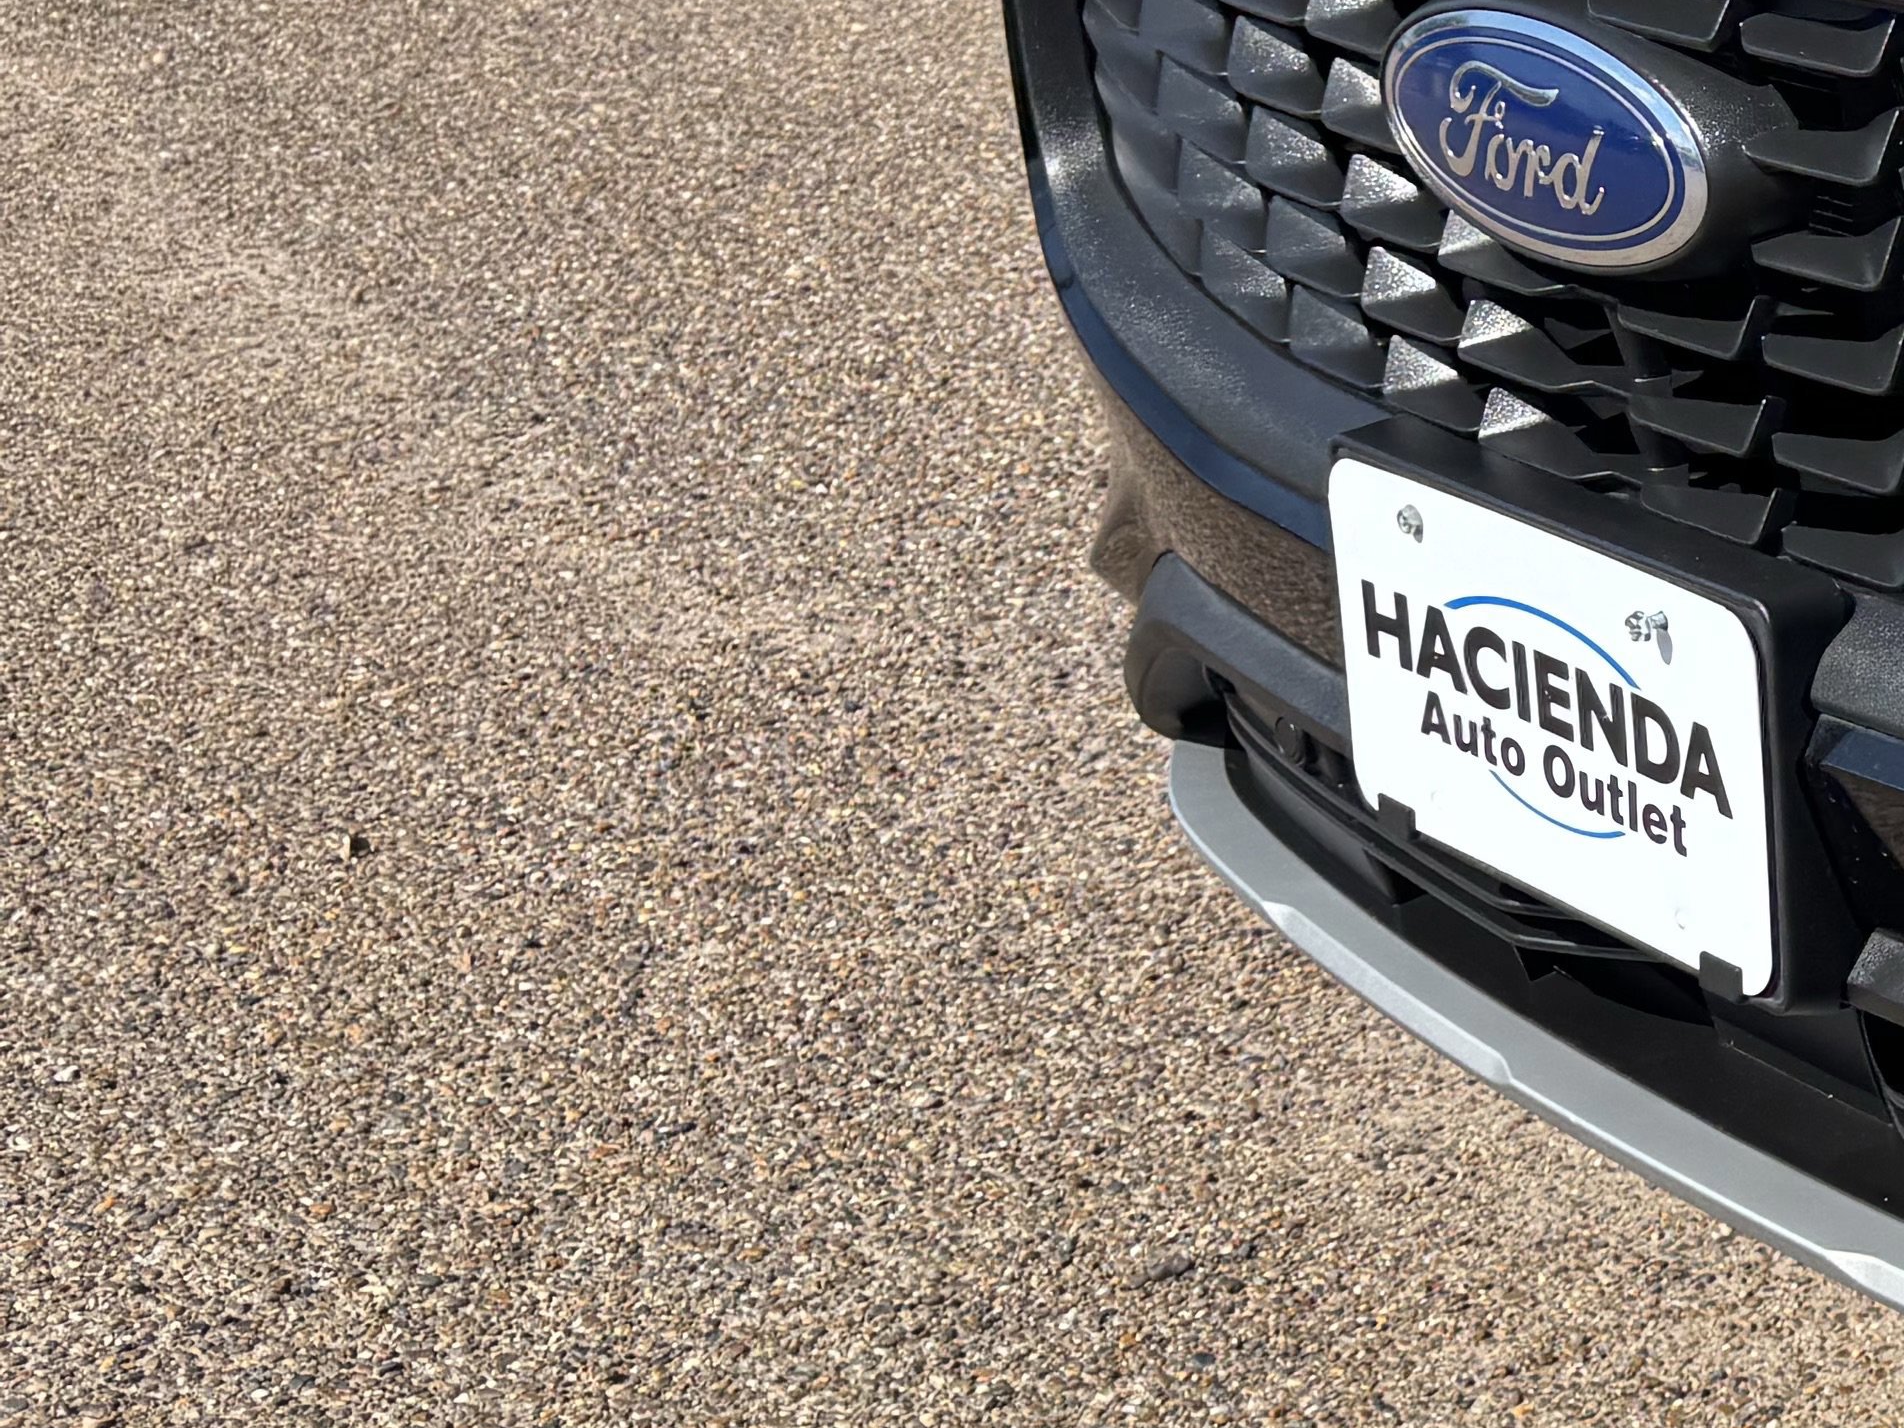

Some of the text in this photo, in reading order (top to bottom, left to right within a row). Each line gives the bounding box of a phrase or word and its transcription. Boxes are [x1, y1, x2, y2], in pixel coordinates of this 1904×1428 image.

[1439, 60, 1605, 215] Ford
[1361, 579, 1734, 820] HACIENDA
[1420, 690, 1688, 858] Auto Outlet
